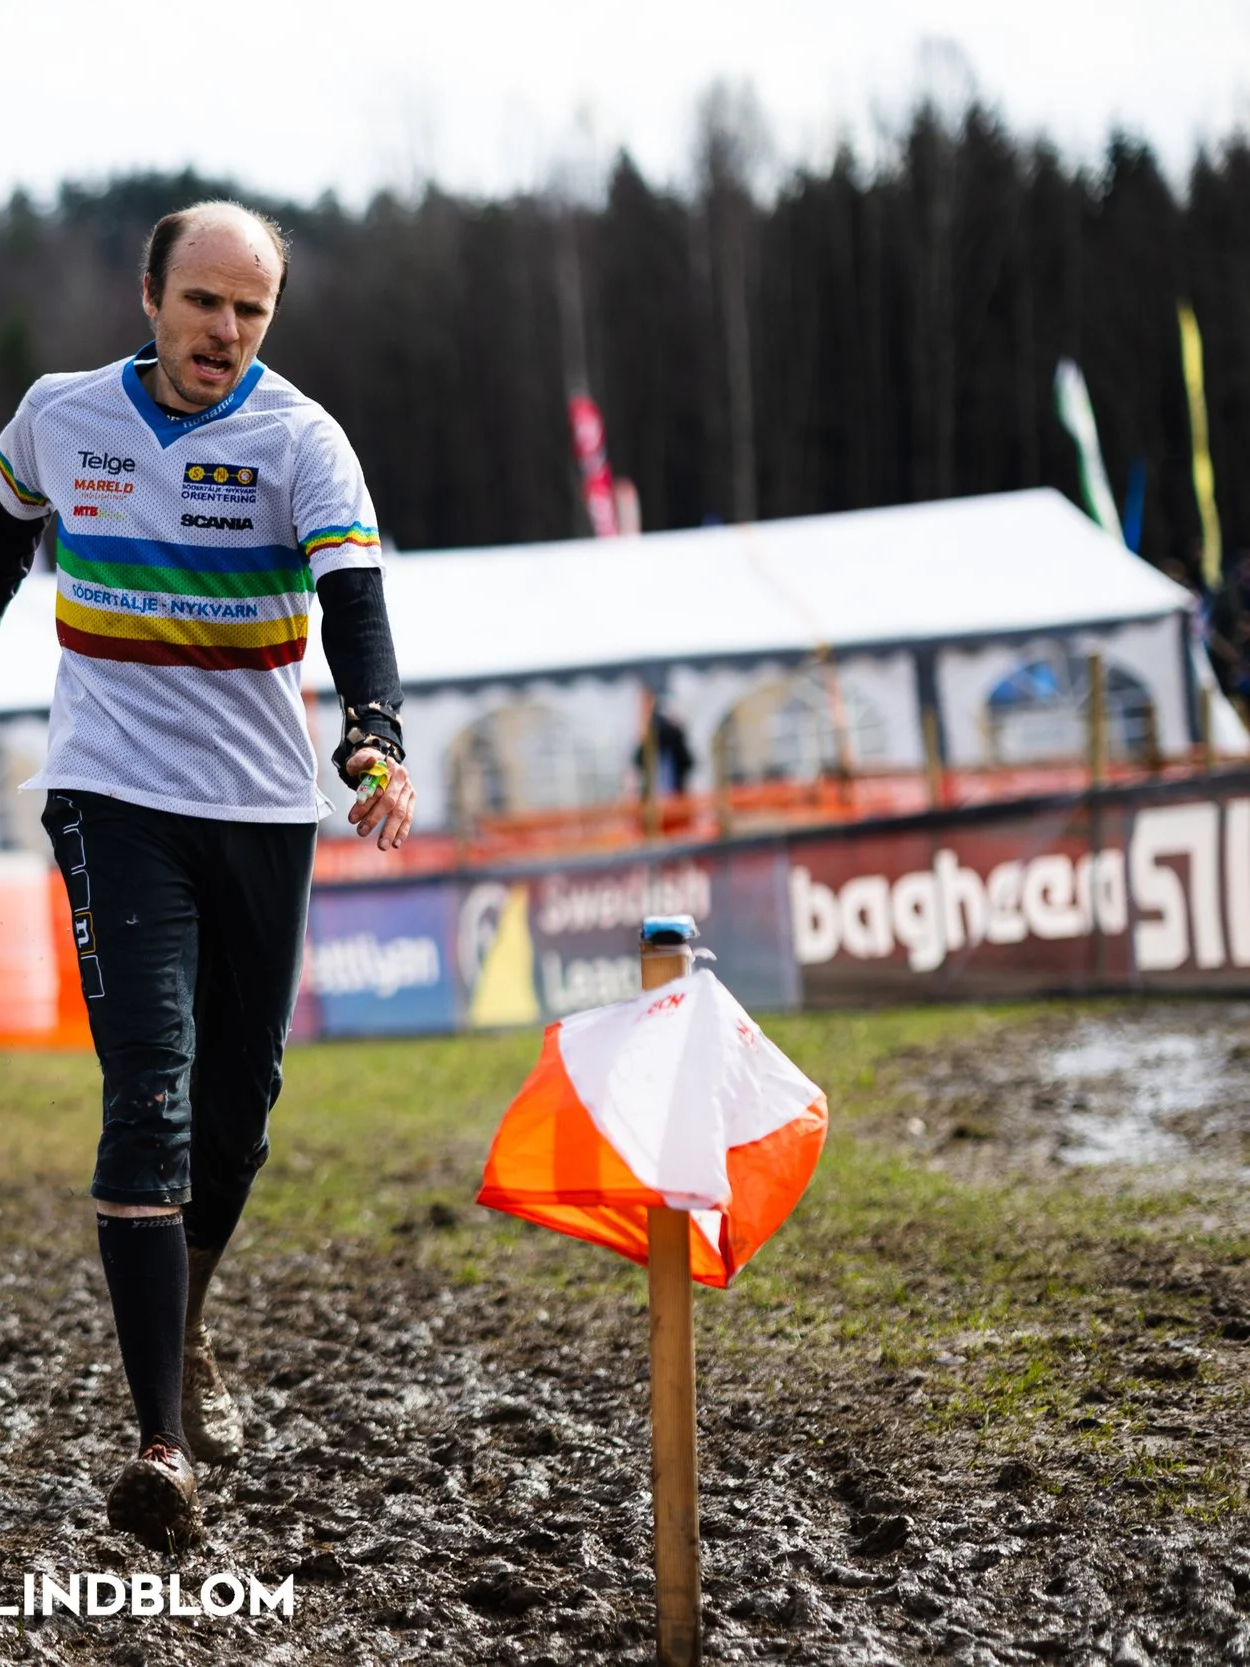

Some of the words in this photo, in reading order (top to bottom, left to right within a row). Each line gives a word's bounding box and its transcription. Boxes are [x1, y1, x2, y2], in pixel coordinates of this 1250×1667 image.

[78, 451, 136, 475] Telge
[74, 479, 134, 494] MARELD
[181, 491, 257, 503] ORIENTERING
[180, 513, 254, 531] SCANIA
[72, 583, 158, 613] SÖDERTÄLJE
[170, 600, 258, 618] NYKVARN
